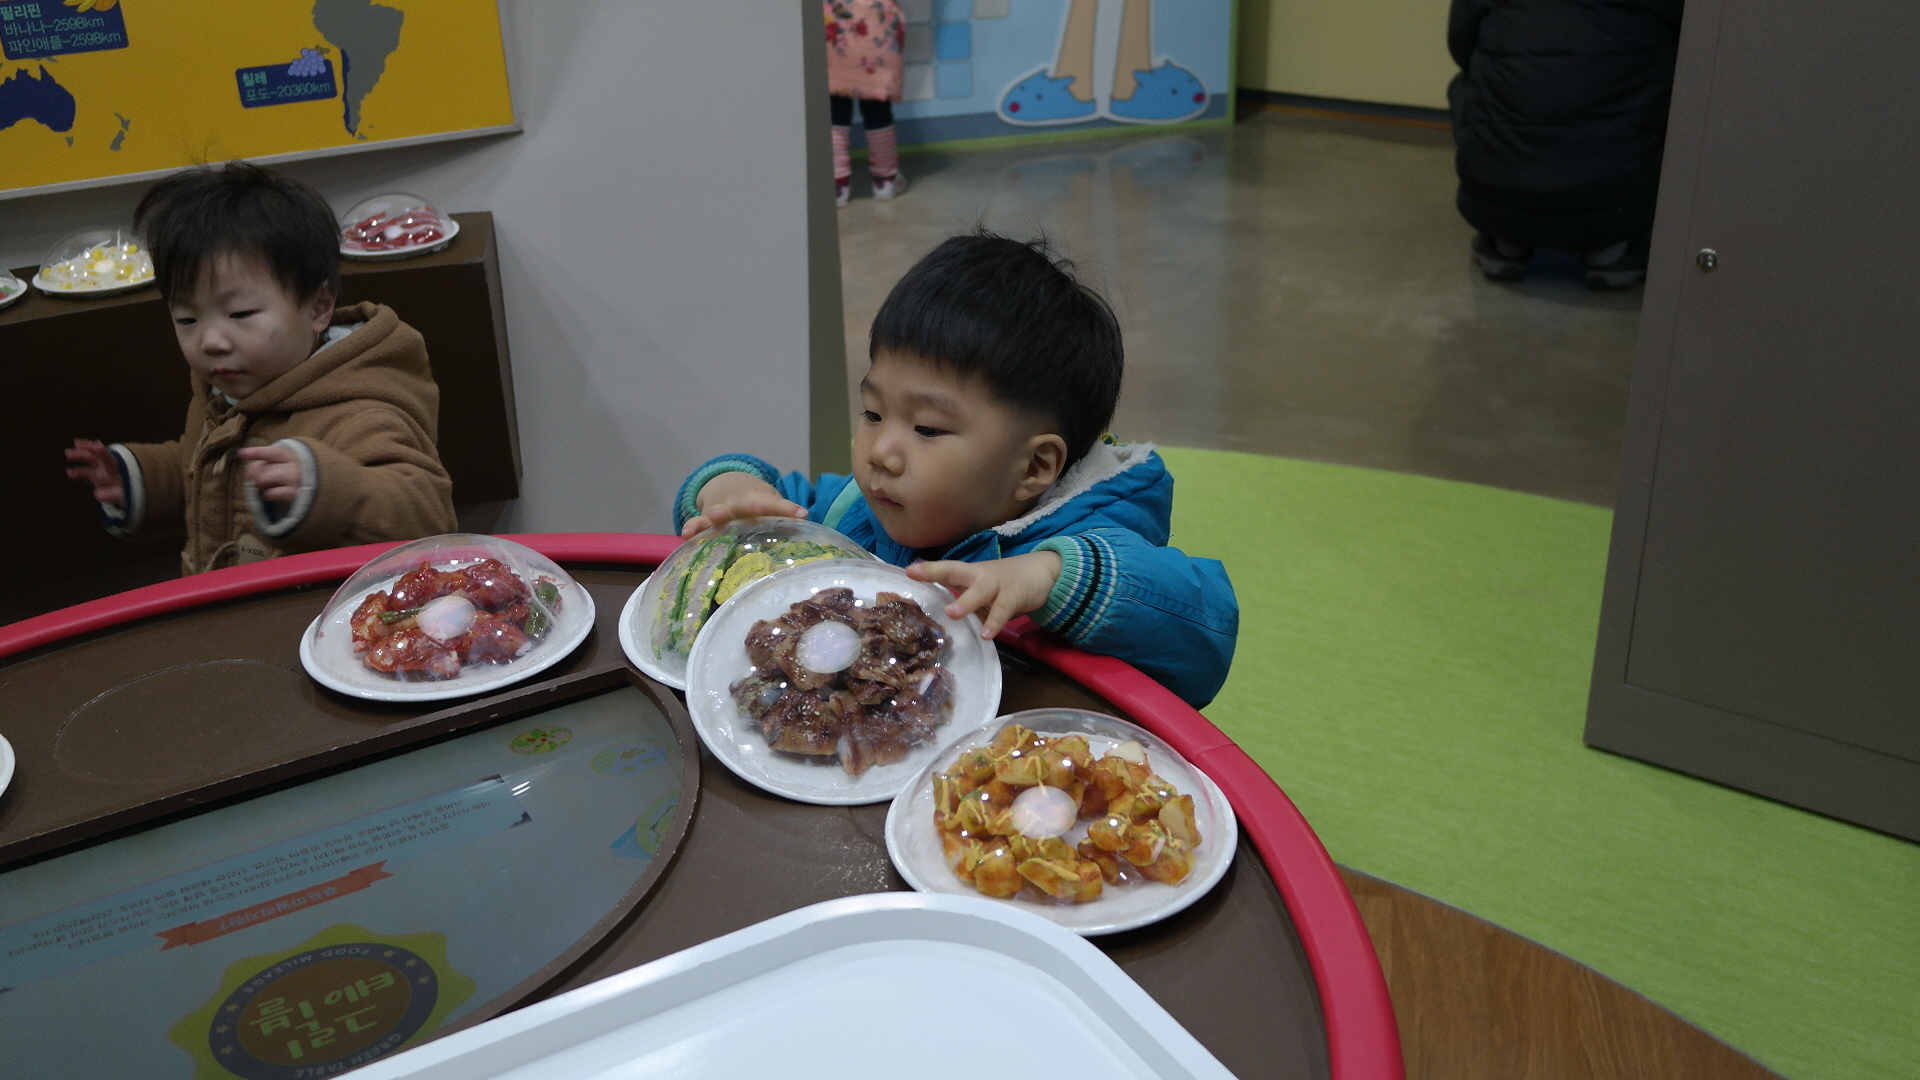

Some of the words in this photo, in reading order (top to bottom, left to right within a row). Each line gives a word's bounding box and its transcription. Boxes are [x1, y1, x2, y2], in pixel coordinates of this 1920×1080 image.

[0, 3, 42, 20] 필리핀
[242, 71, 268, 87] 칠레
[442, 799, 490, 820] 이동거리가
[358, 822, 385, 837] 재료로
[372, 828, 400, 843] 이동을
[323, 833, 352, 848] 음식을
[348, 838, 367, 850] 위한
[288, 843, 320, 860] 만들어
[313, 845, 344, 861] 에너지
[278, 857, 309, 873] 소비가
[216, 866, 246, 882] 신선한
[209, 878, 240, 894] 지구를
[157, 902, 199, 920] 이동하는
[158, 897, 178, 910] 하는
[218, 883, 336, 931] 푸드마일리지란?
[98, 906, 152, 929] 온실가스가
[118, 917, 150, 933] 거리를
[321, 946, 371, 959] FOOD
[242, 954, 313, 995] MILEAGE
[249, 972, 396, 1036] 테이블
[286, 1005, 377, 1059] 그린
[350, 1033, 402, 1069] GREEN
[293, 1058, 347, 1079] TABLE
